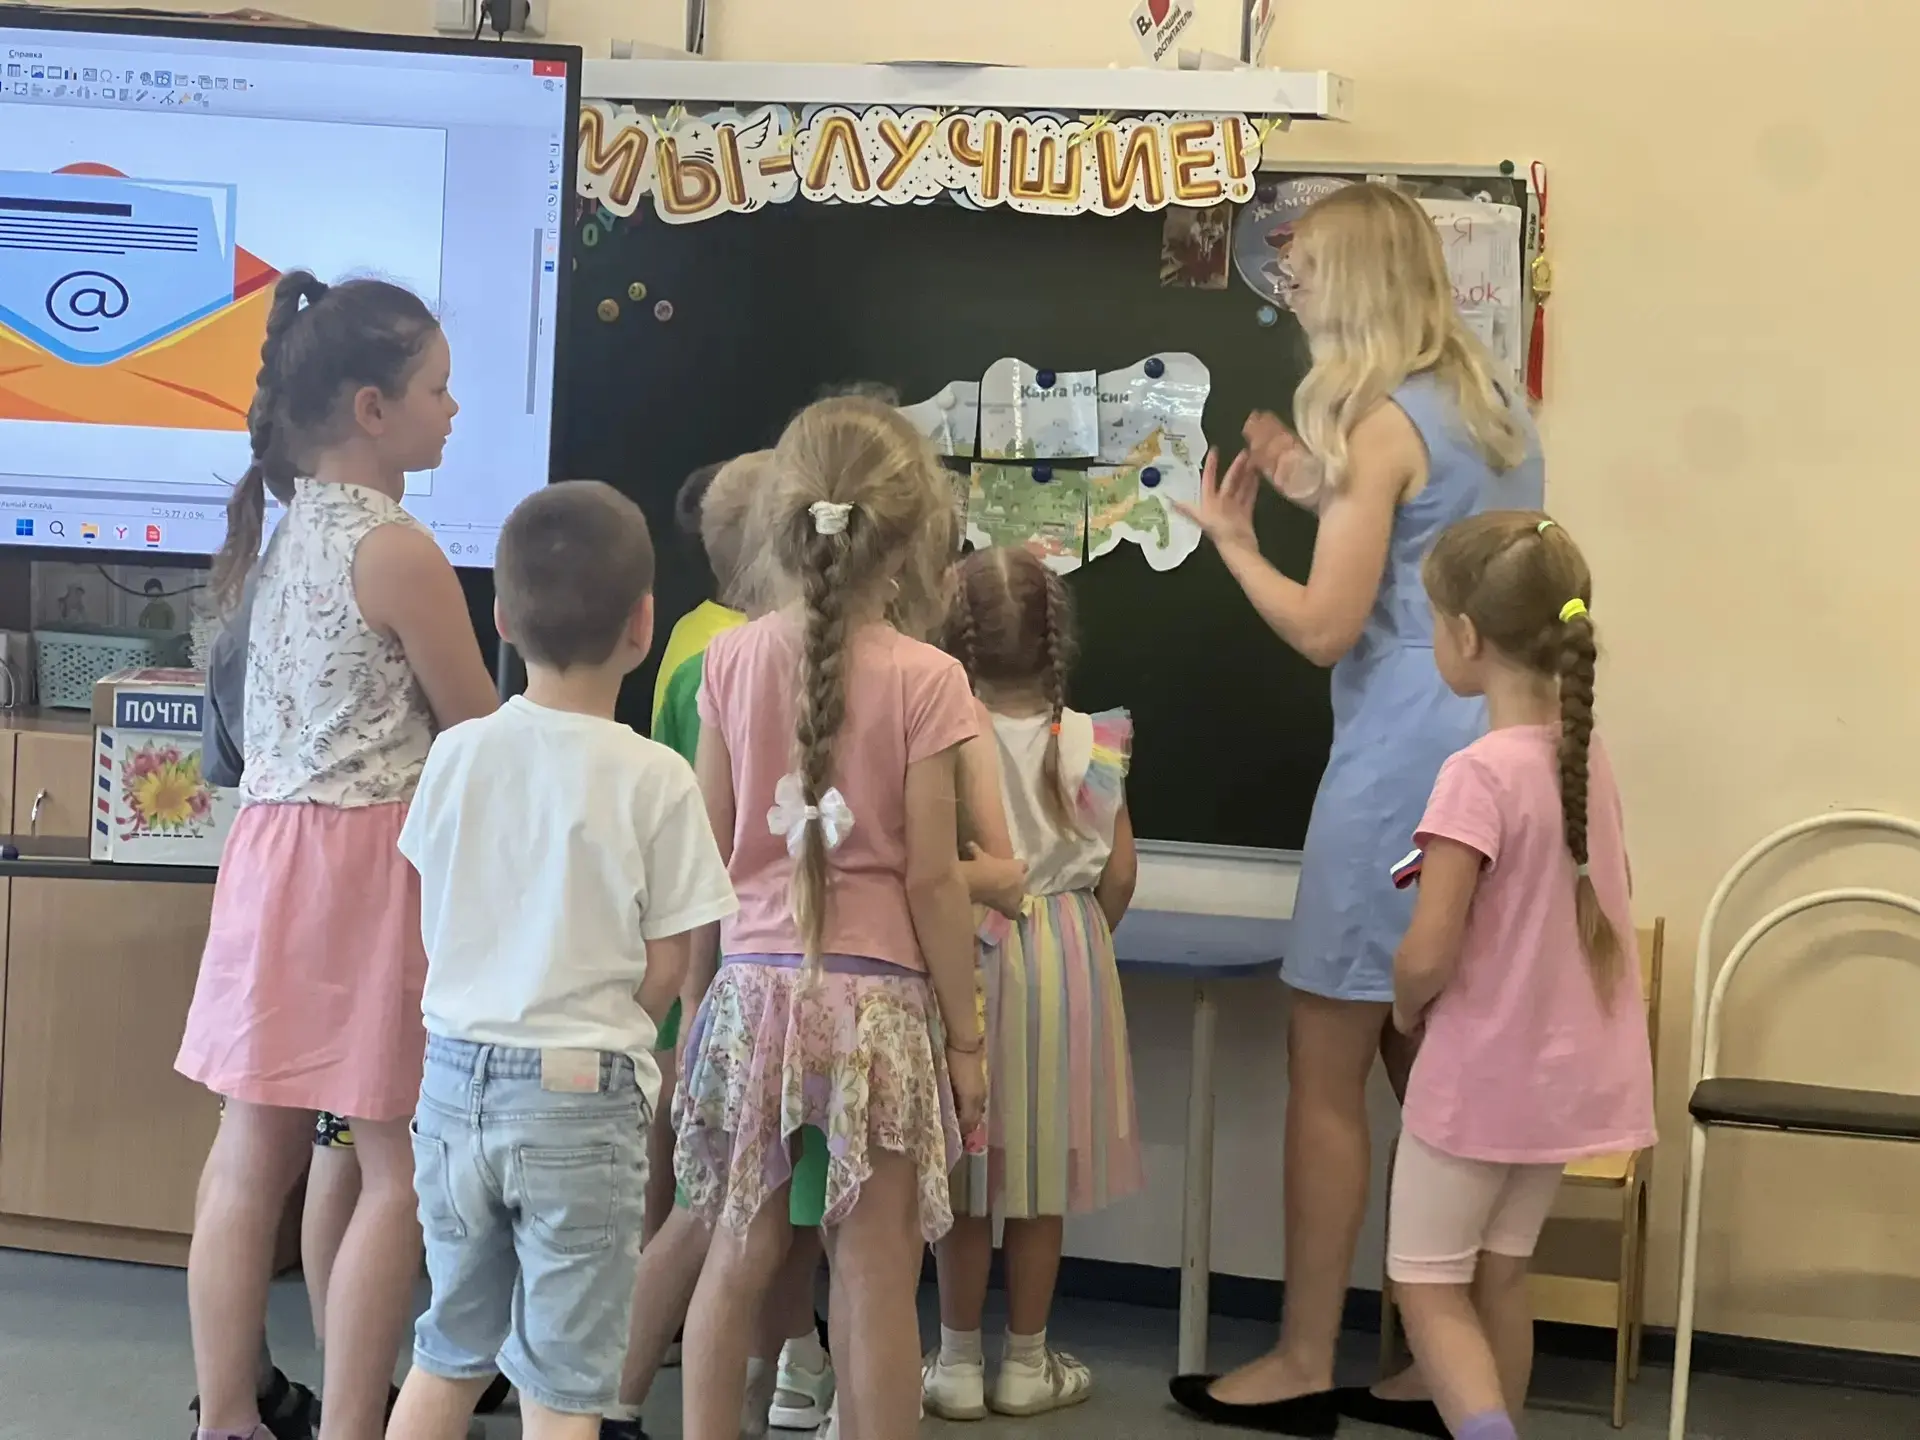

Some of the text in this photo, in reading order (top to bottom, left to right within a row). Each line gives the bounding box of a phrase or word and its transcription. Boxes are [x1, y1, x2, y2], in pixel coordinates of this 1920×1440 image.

[1153, 10, 1193, 61] ВОСПИТАТЕЛЬ
[1157, 5, 1181, 42] ЛУЧШИЙ
[8, 49, 43, 59] Справка
[1020, 384, 1068, 402] Карта
[125, 700, 197, 725] ПОЧТА
